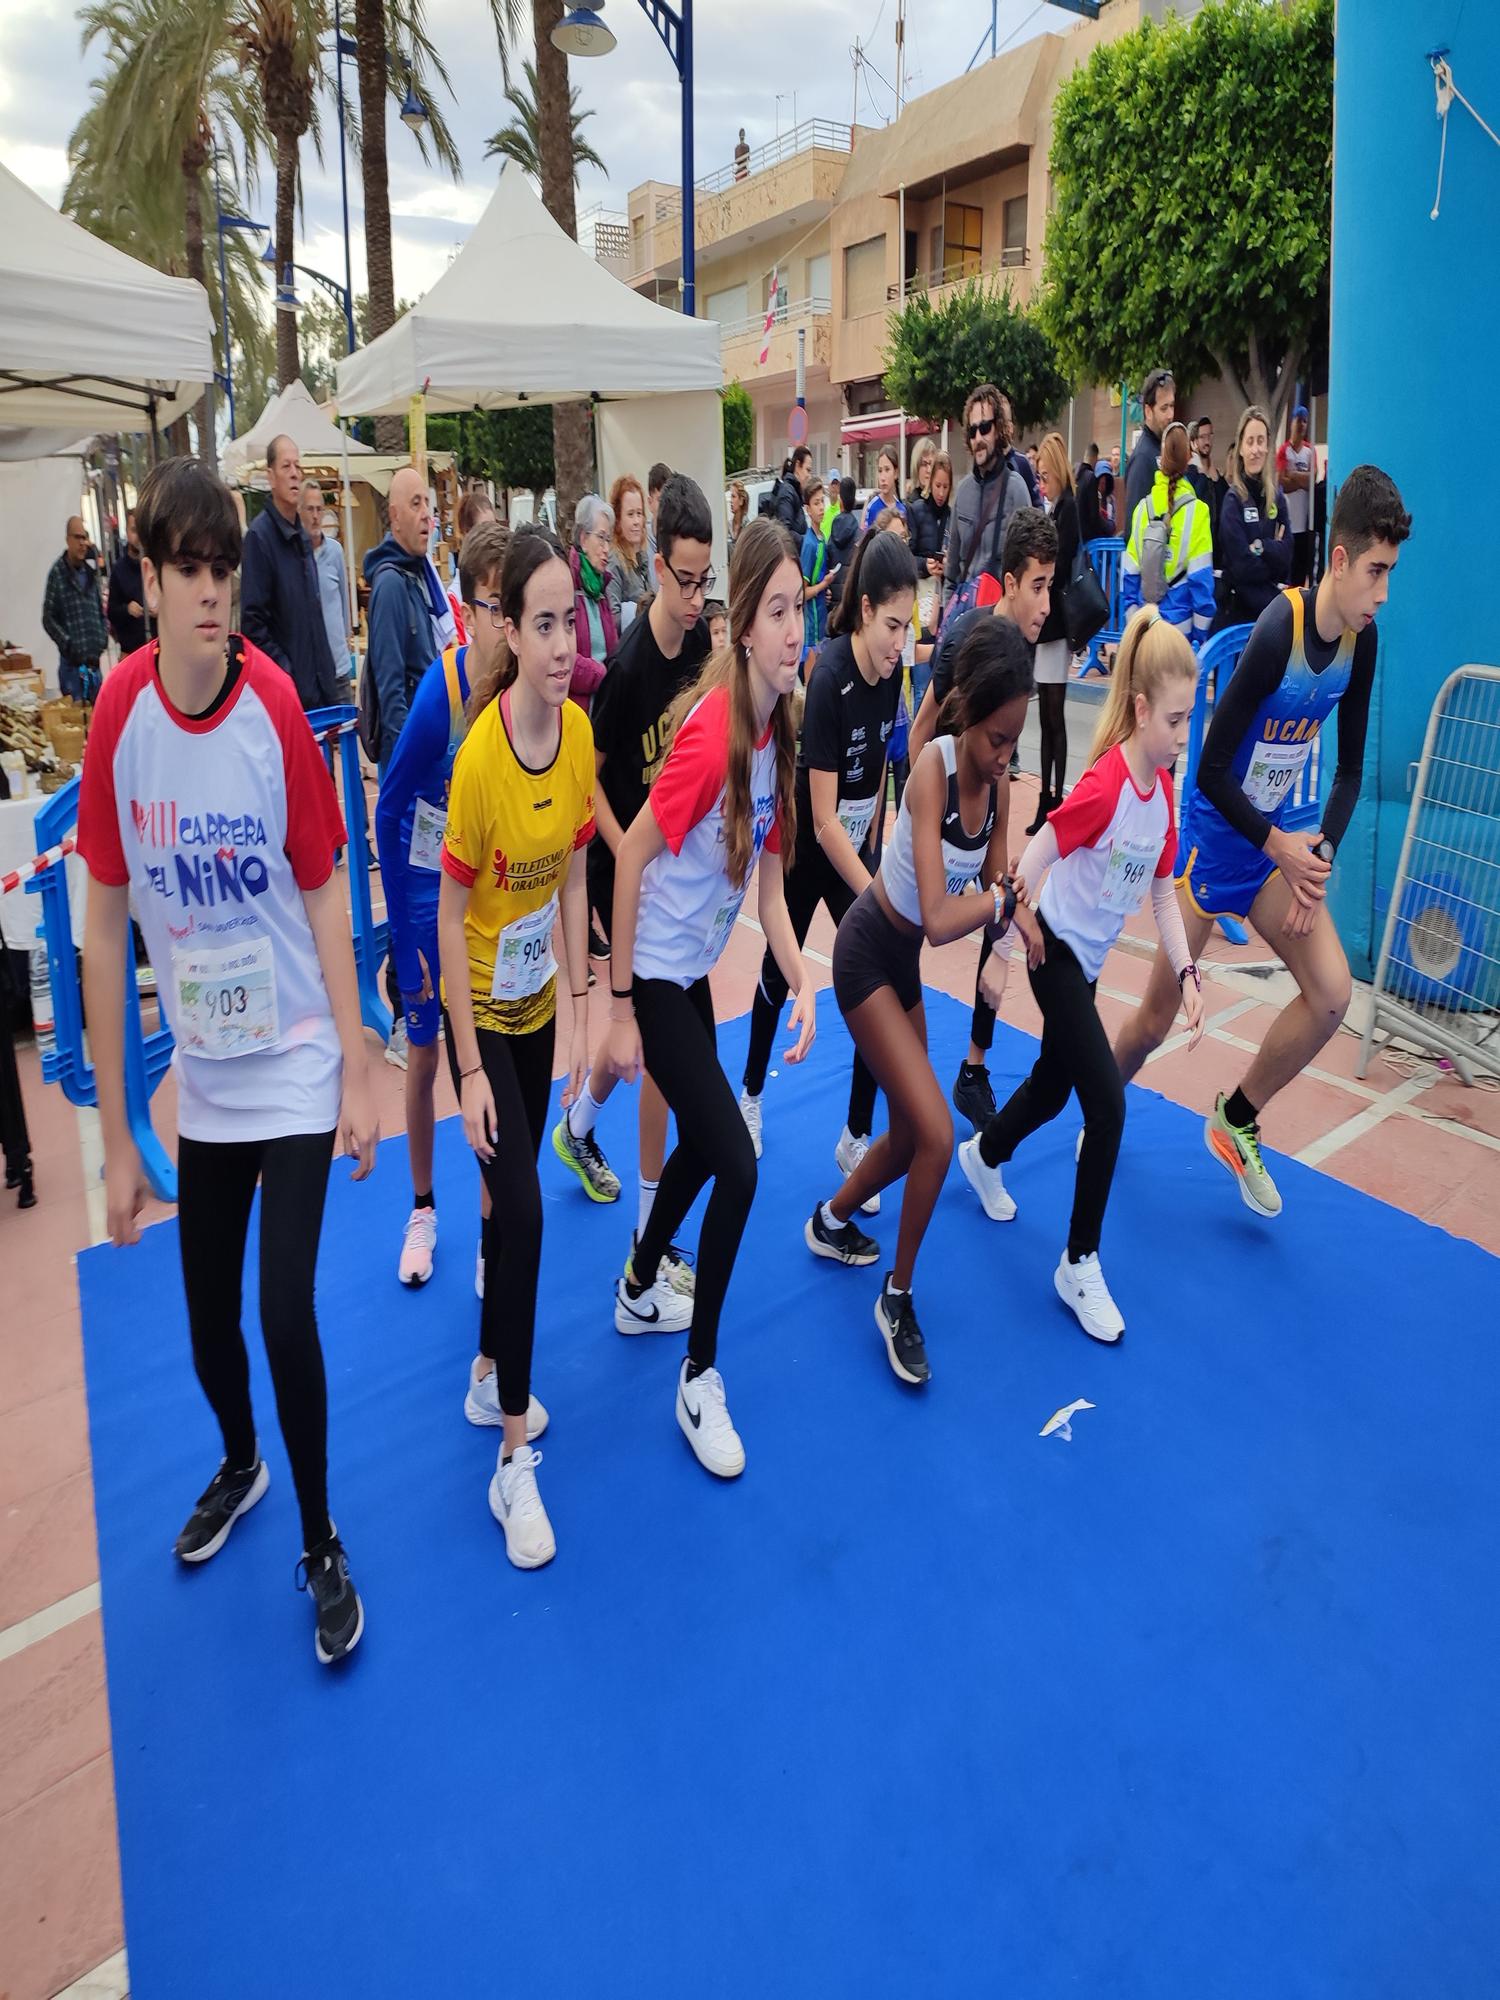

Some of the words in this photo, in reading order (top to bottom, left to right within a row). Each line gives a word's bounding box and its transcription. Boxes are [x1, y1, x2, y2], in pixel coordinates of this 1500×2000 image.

[1266, 768, 1293, 787] 907
[130, 799, 177, 849] VIII
[178, 811, 268, 847] CARRERA
[849, 819, 867, 839] 910
[506, 848, 564, 874] ATLETISMO
[1122, 862, 1146, 884] 969
[205, 985, 247, 1019] 903
